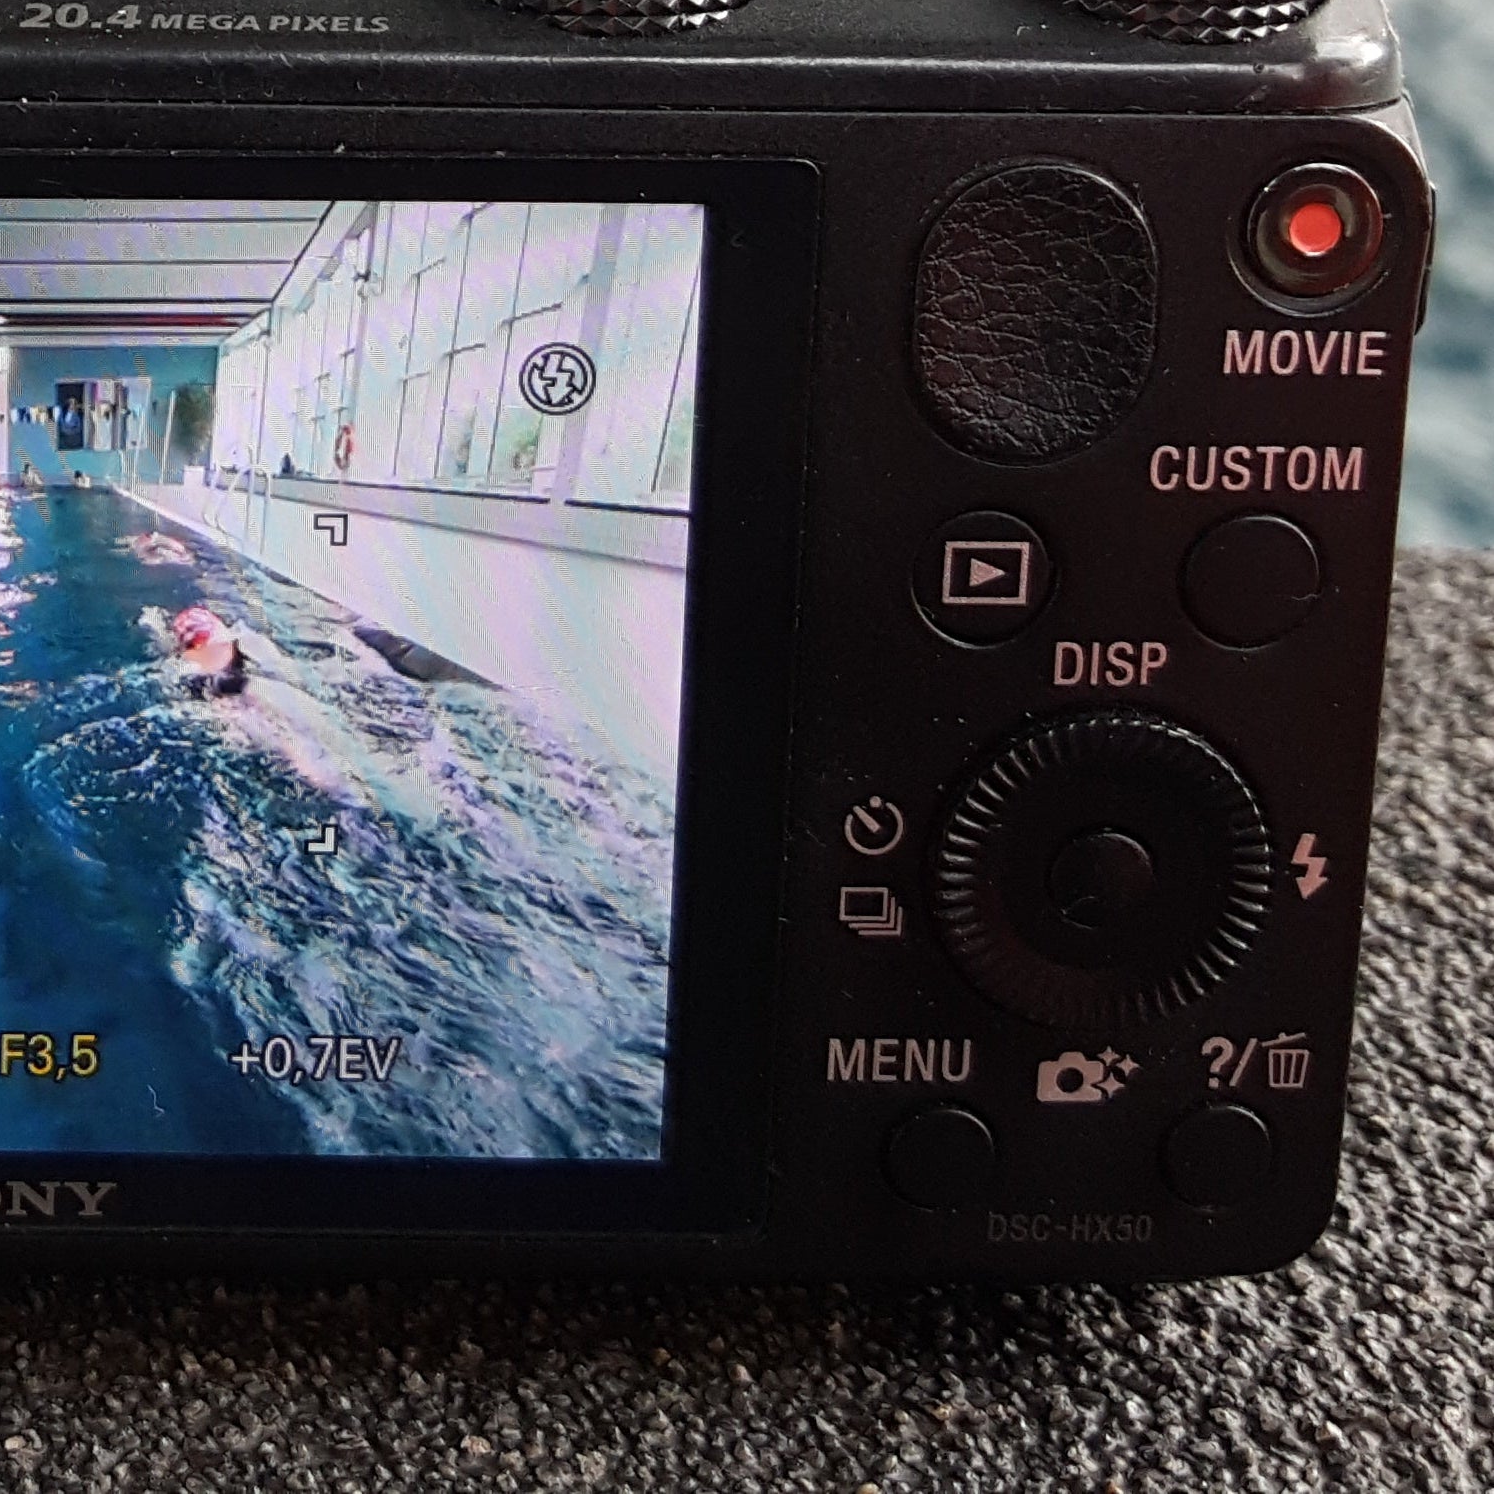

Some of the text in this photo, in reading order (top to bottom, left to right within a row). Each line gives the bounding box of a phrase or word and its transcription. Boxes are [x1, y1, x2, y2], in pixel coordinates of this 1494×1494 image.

[19, 2, 143, 29] 20.4
[151, 13, 261, 31] MEGA
[268, 15, 390, 33] PIXELS
[1222, 329, 1388, 377] MOVIE
[1149, 445, 1364, 492] CUSTOM
[1053, 641, 1169, 687] DISP
[826, 1038, 973, 1083] MENU
[987, 1212, 1154, 1243] DSC-HX50
